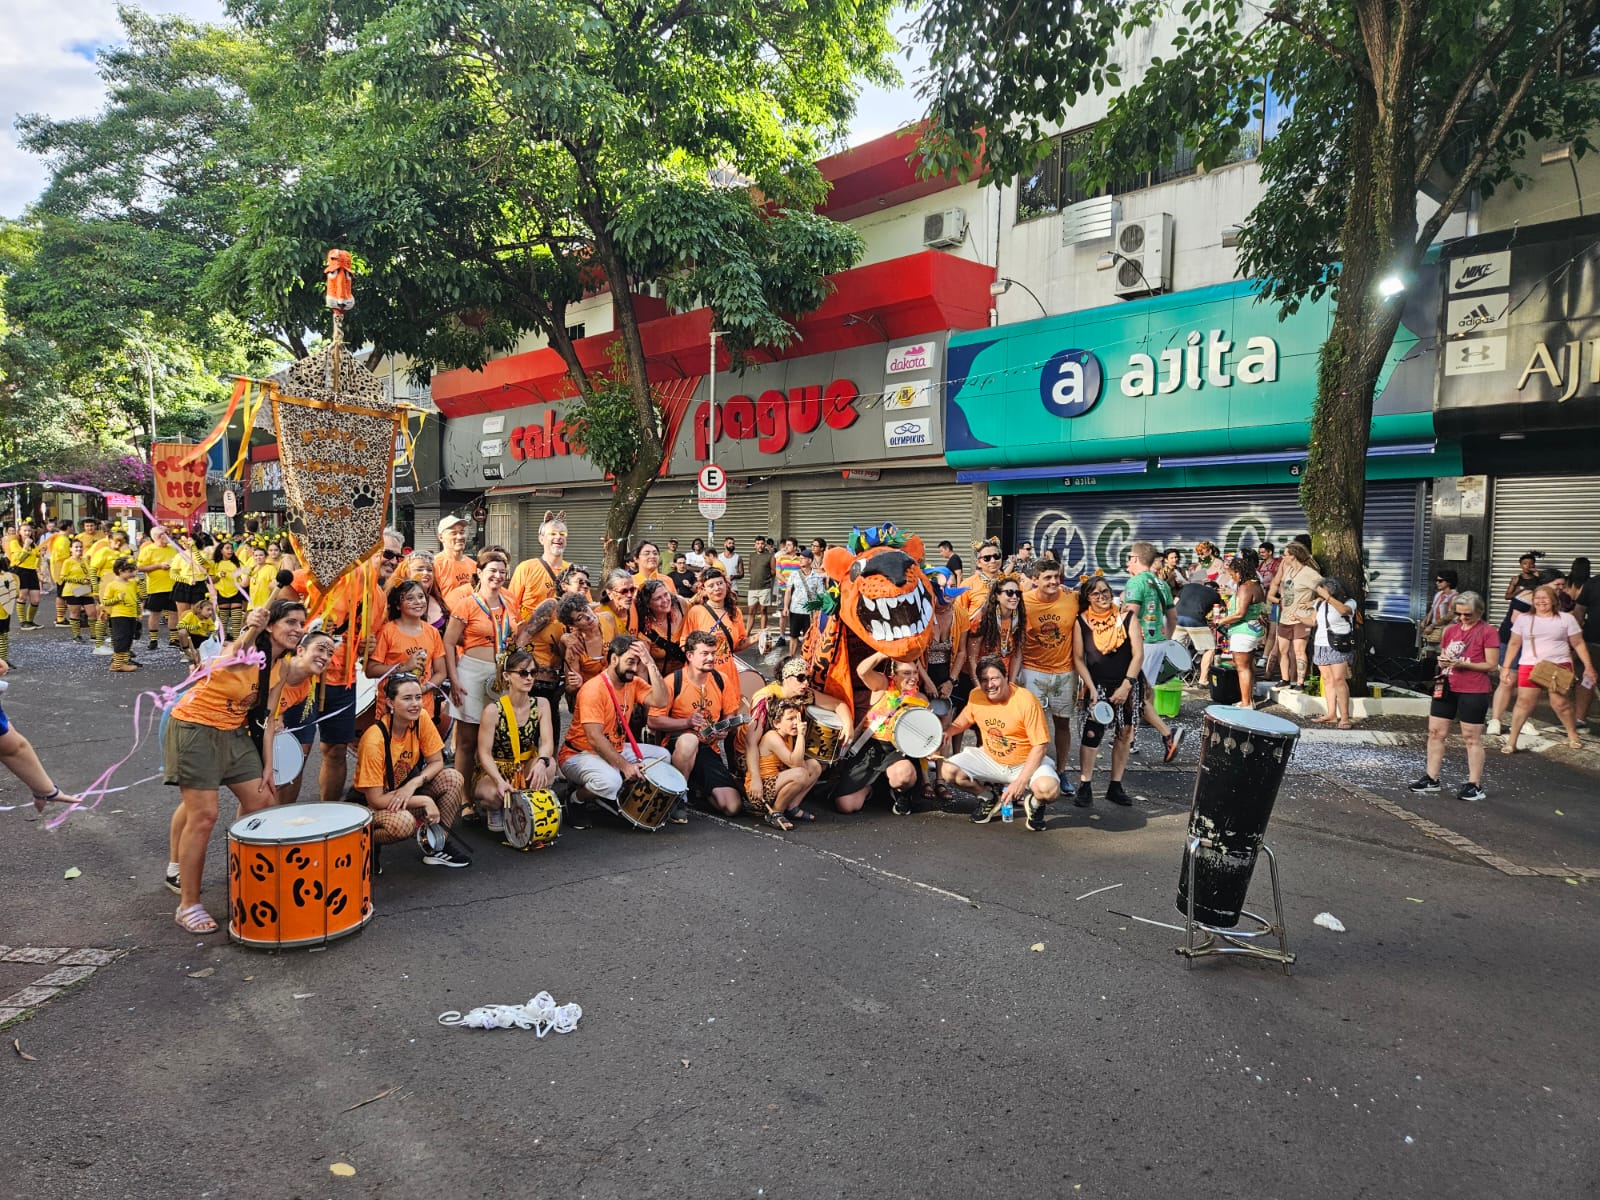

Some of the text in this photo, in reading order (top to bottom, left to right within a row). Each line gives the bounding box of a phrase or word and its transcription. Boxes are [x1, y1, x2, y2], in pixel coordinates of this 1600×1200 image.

[1463, 263, 1492, 279] NIKE
[1458, 314, 1496, 327] adidas
[890, 357, 926, 372] dakota
[1120, 328, 1279, 397] ajita
[694, 378, 860, 461] pague
[889, 434, 925, 446] OLYMPIKUS
[707, 470, 717, 486] E
[167, 481, 201, 498] MEL
[310, 541, 342, 550] 2023
[1038, 613, 1061, 623] BLOCO
[985, 718, 1005, 729] BLOCO
